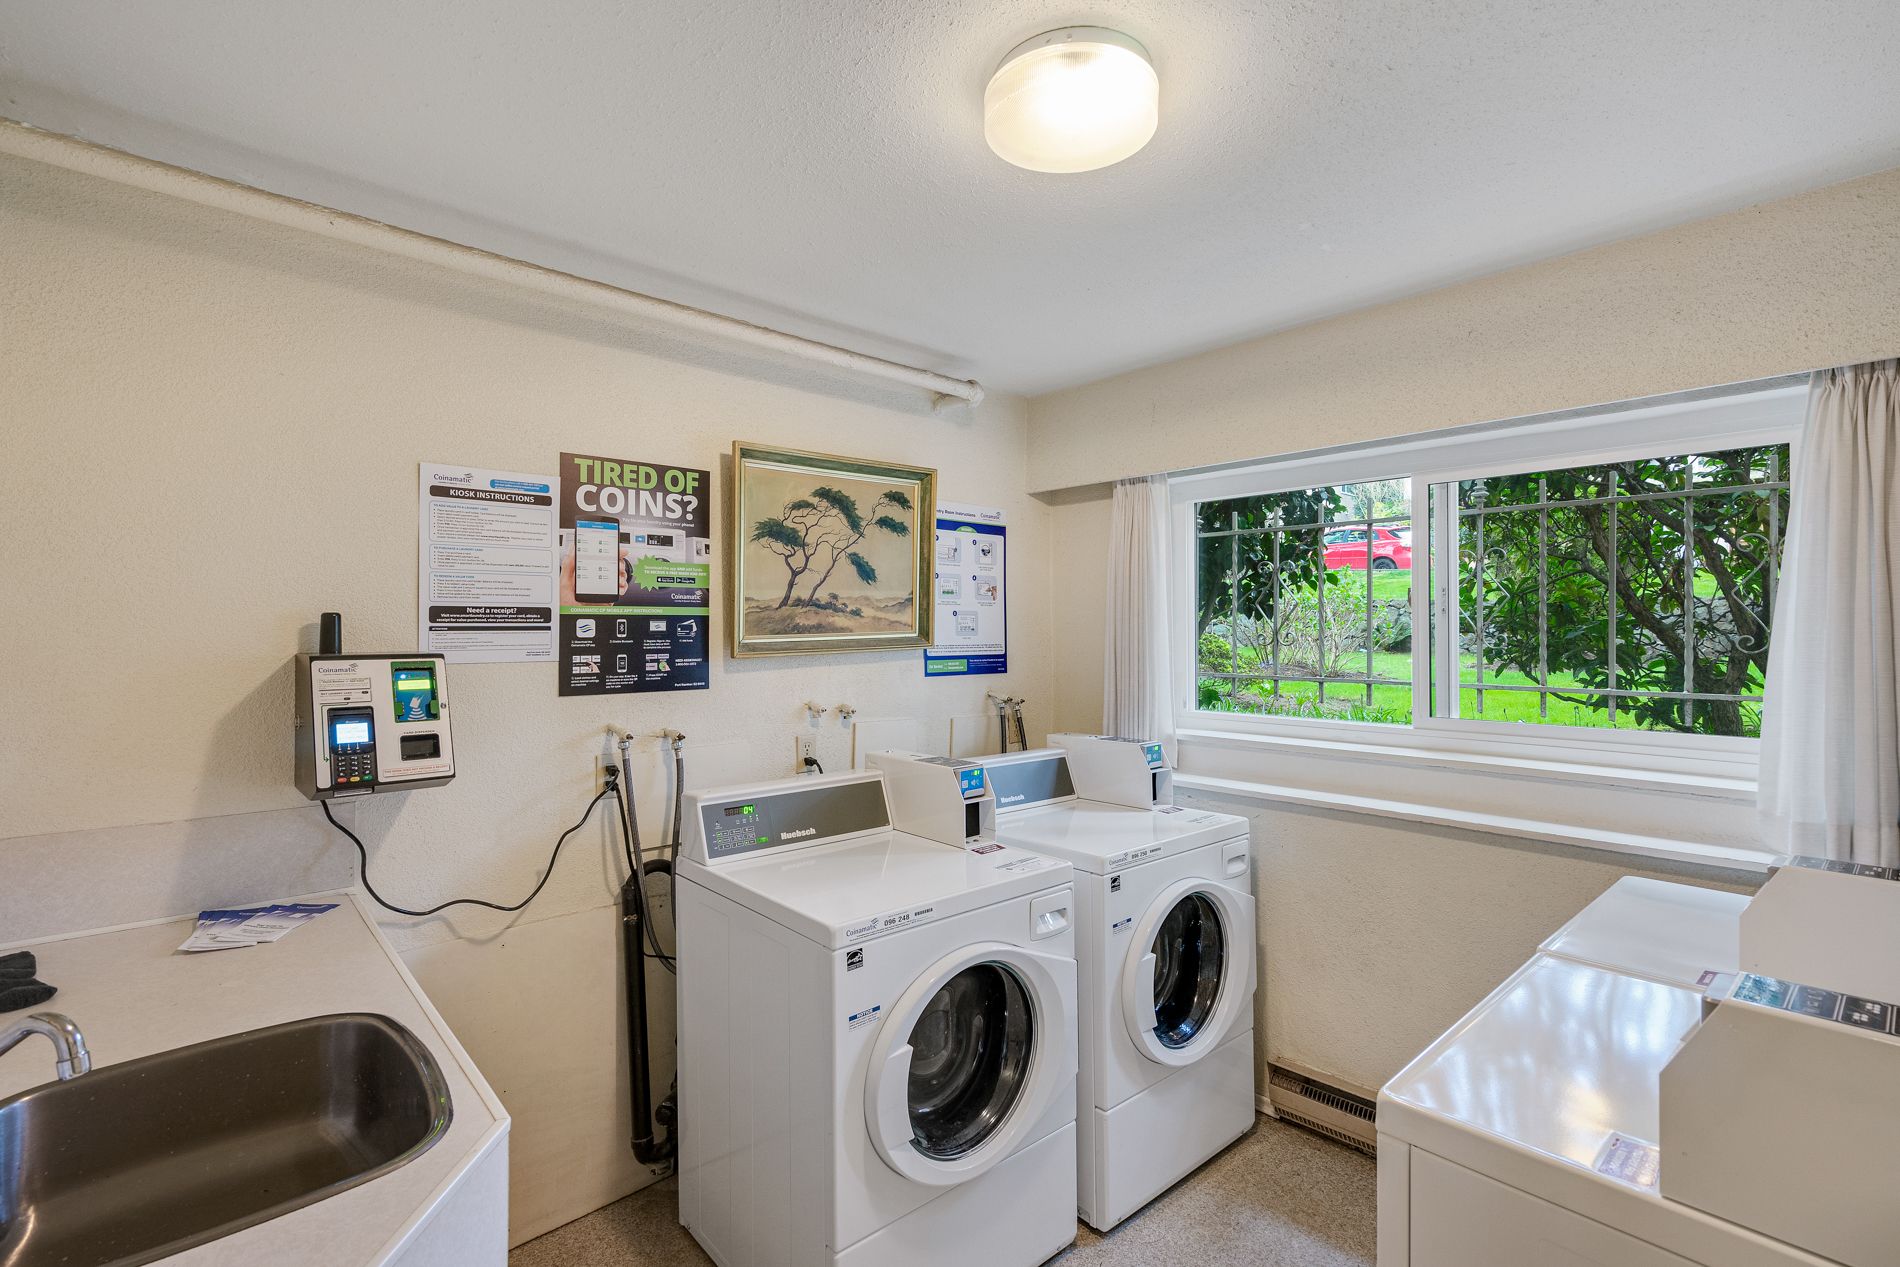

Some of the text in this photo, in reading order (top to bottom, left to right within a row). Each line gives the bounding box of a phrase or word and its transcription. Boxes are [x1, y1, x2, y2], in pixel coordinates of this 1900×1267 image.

[434, 473, 472, 484] Coinamatic
[574, 458, 699, 495] TIRED OF
[450, 488, 535, 503] KIOSK INSTRUCTIONS
[576, 484, 698, 521] COINS?
[1000, 794, 1025, 804] Huebsch
[744, 806, 753, 814] 04
[780, 828, 816, 840] Huebsch
[846, 914, 910, 937] Coinamatic 096 248
[856, 1008, 873, 1018] NOTICE
